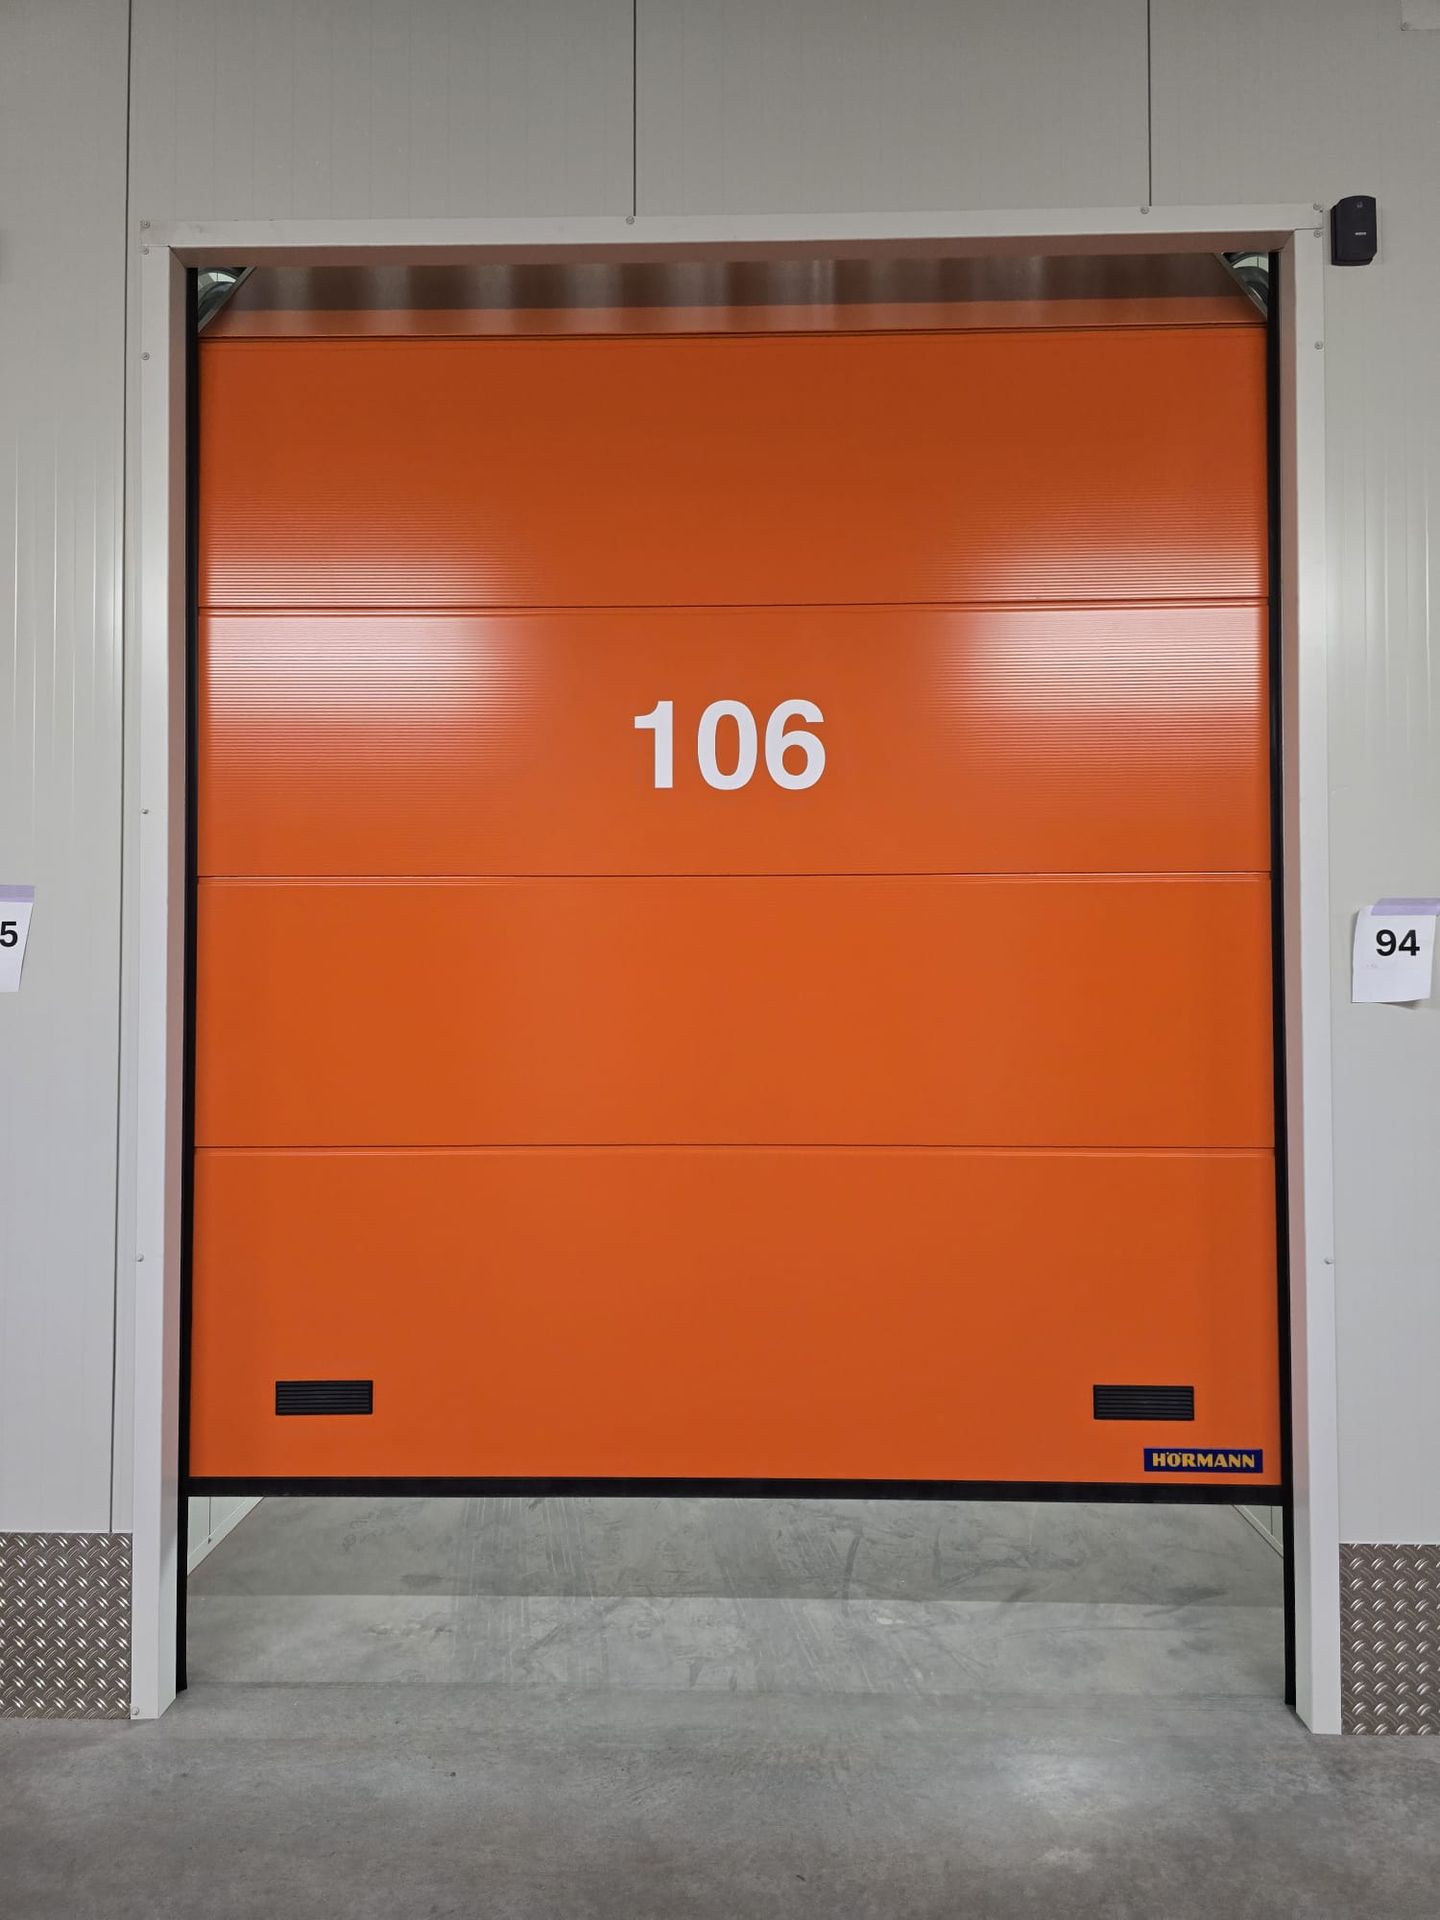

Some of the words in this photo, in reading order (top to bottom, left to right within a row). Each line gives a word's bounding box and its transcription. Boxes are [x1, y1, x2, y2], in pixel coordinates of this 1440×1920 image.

[634, 699, 826, 790] 106
[1376, 929, 1420, 956] 94
[1152, 1451, 1255, 1468] HÖRMANN
